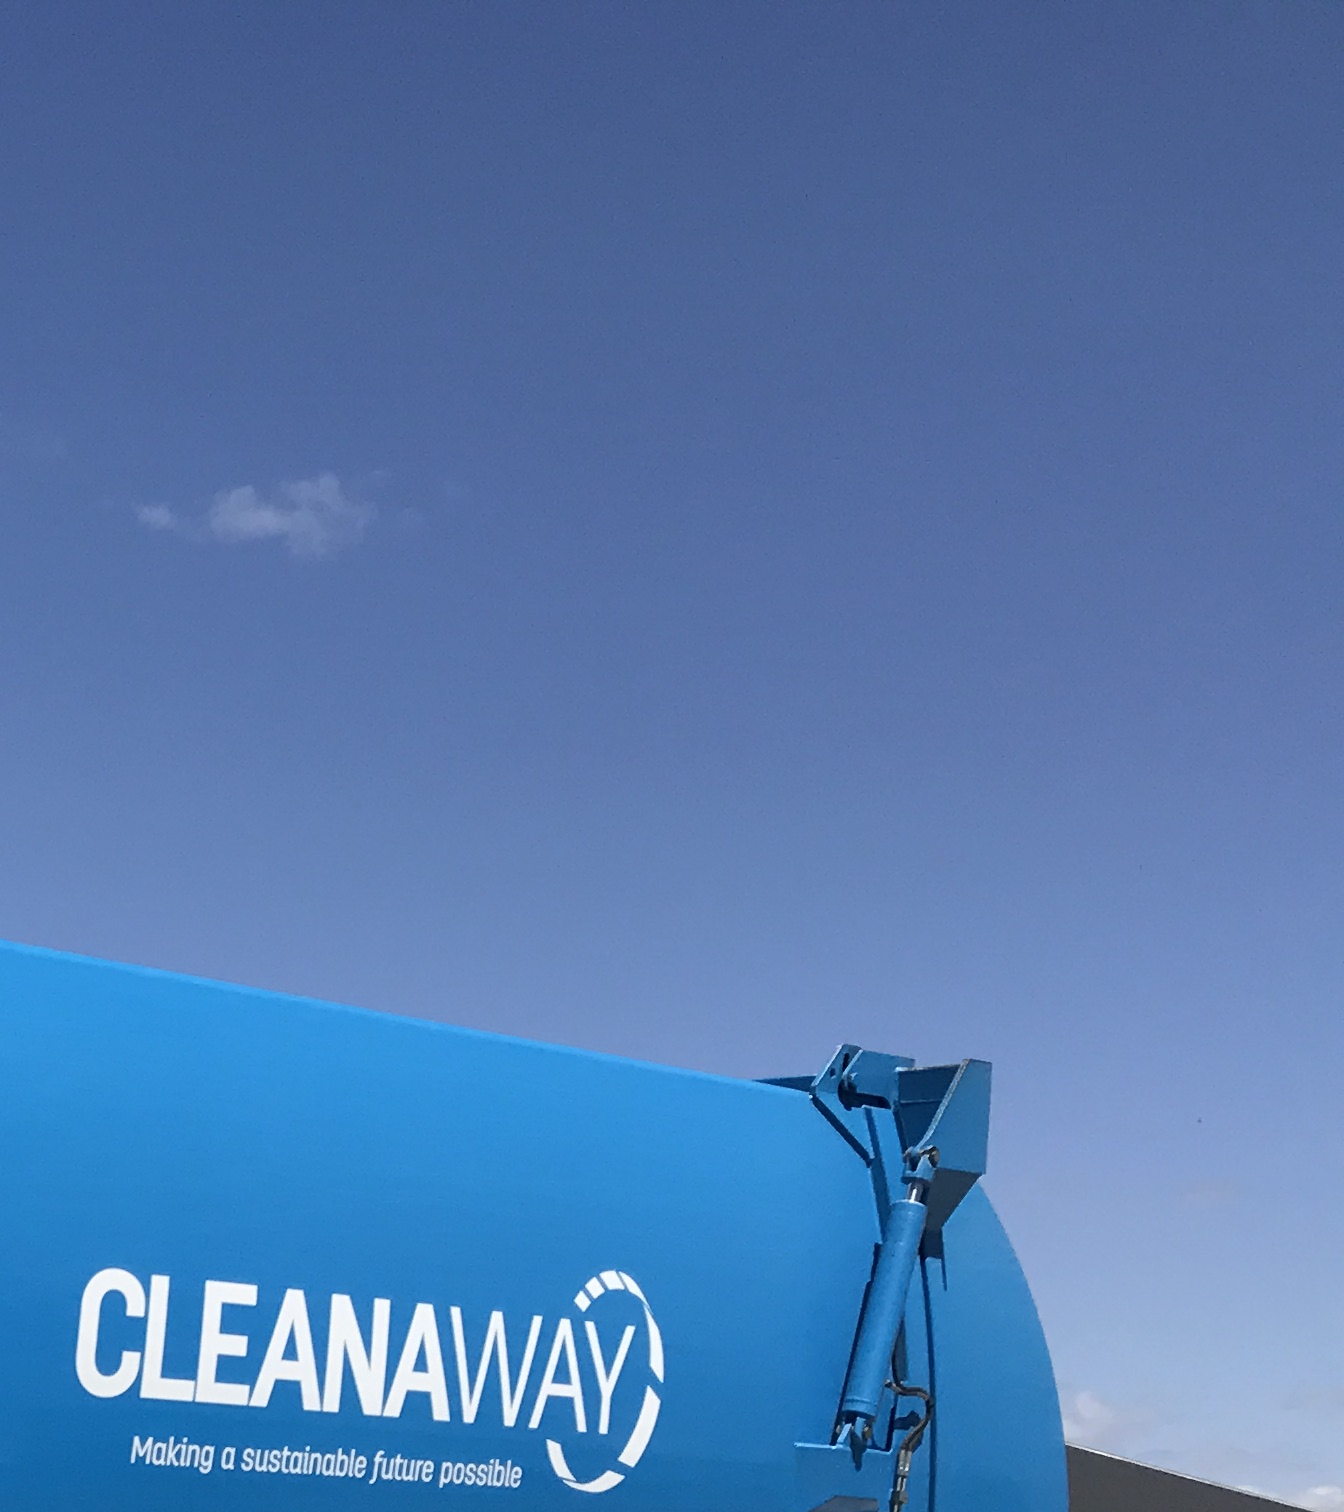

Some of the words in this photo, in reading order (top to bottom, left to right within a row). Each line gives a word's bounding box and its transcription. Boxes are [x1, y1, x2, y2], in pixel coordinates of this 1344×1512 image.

[75, 1267, 635, 1435] CLEANAWAY
[130, 1434, 216, 1475] Making
[221, 1446, 236, 1471] a
[241, 1443, 367, 1480] sustainable
[369, 1450, 434, 1485] future
[439, 1456, 524, 1489] possible
